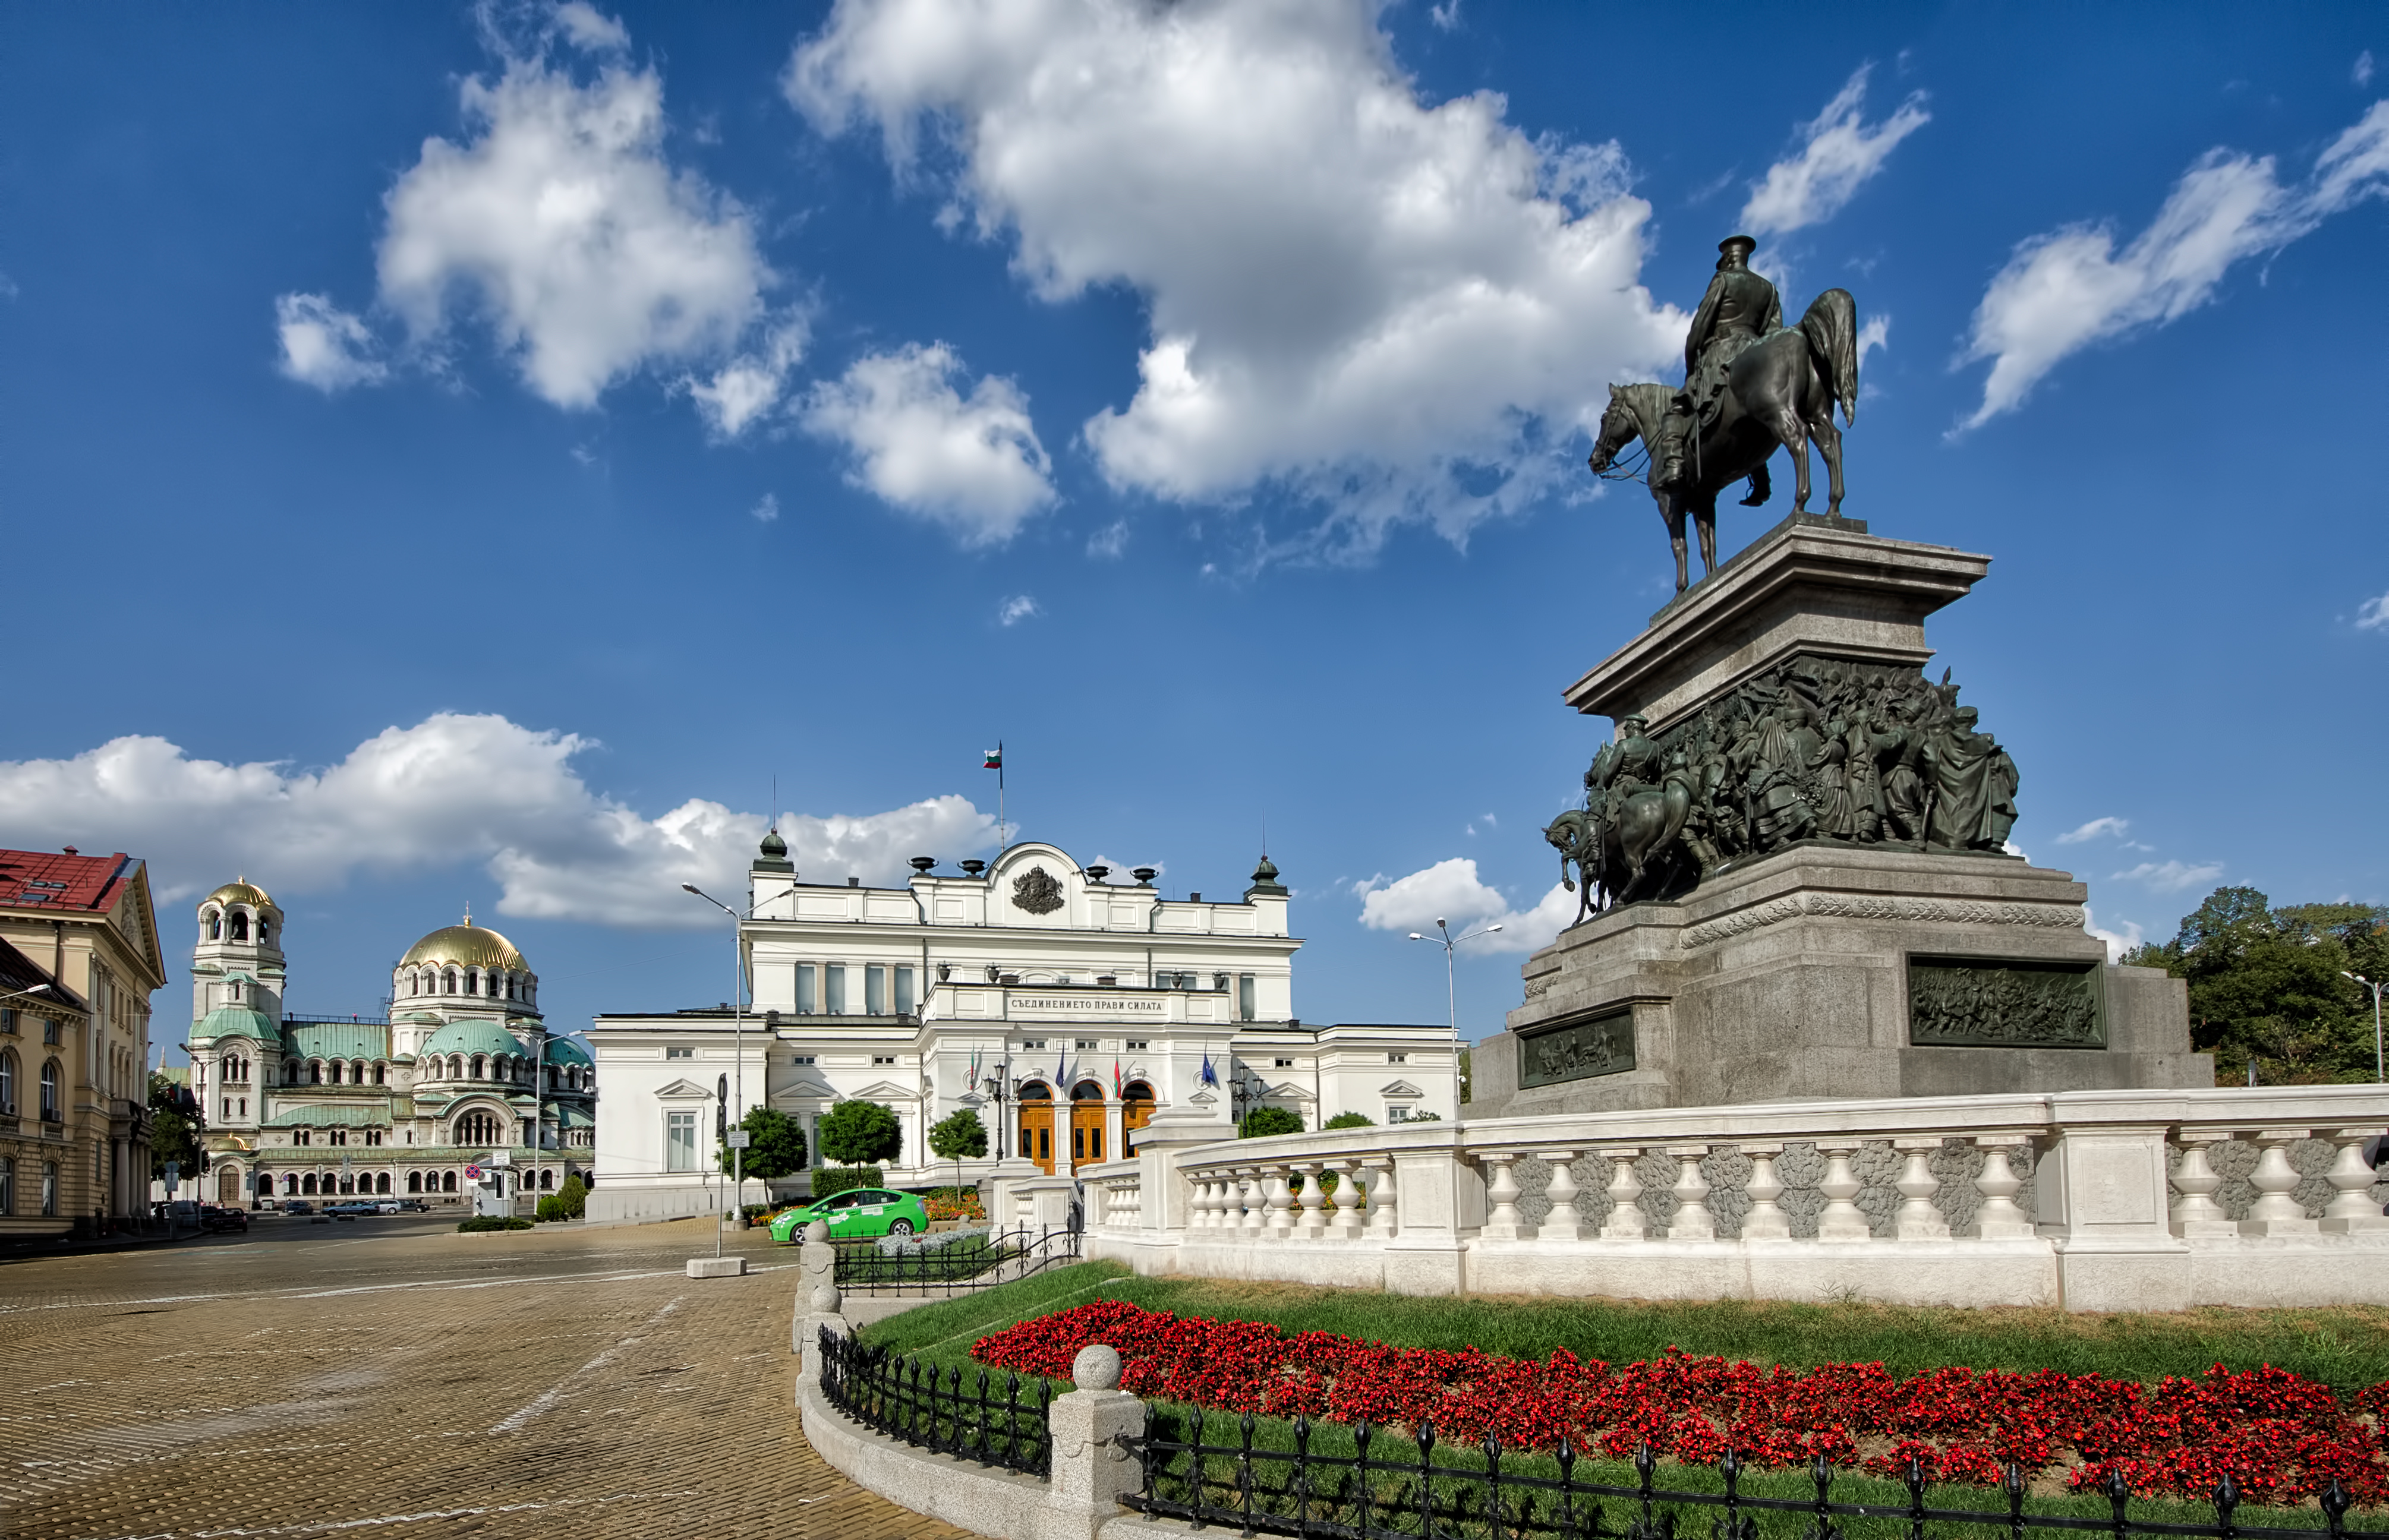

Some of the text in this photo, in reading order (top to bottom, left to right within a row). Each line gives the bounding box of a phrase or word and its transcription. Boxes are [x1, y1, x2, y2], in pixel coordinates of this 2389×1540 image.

[1011, 999, 1162, 1011] СЪЕДИНЕНИЕТО ПРАВИ СИЛАТА
